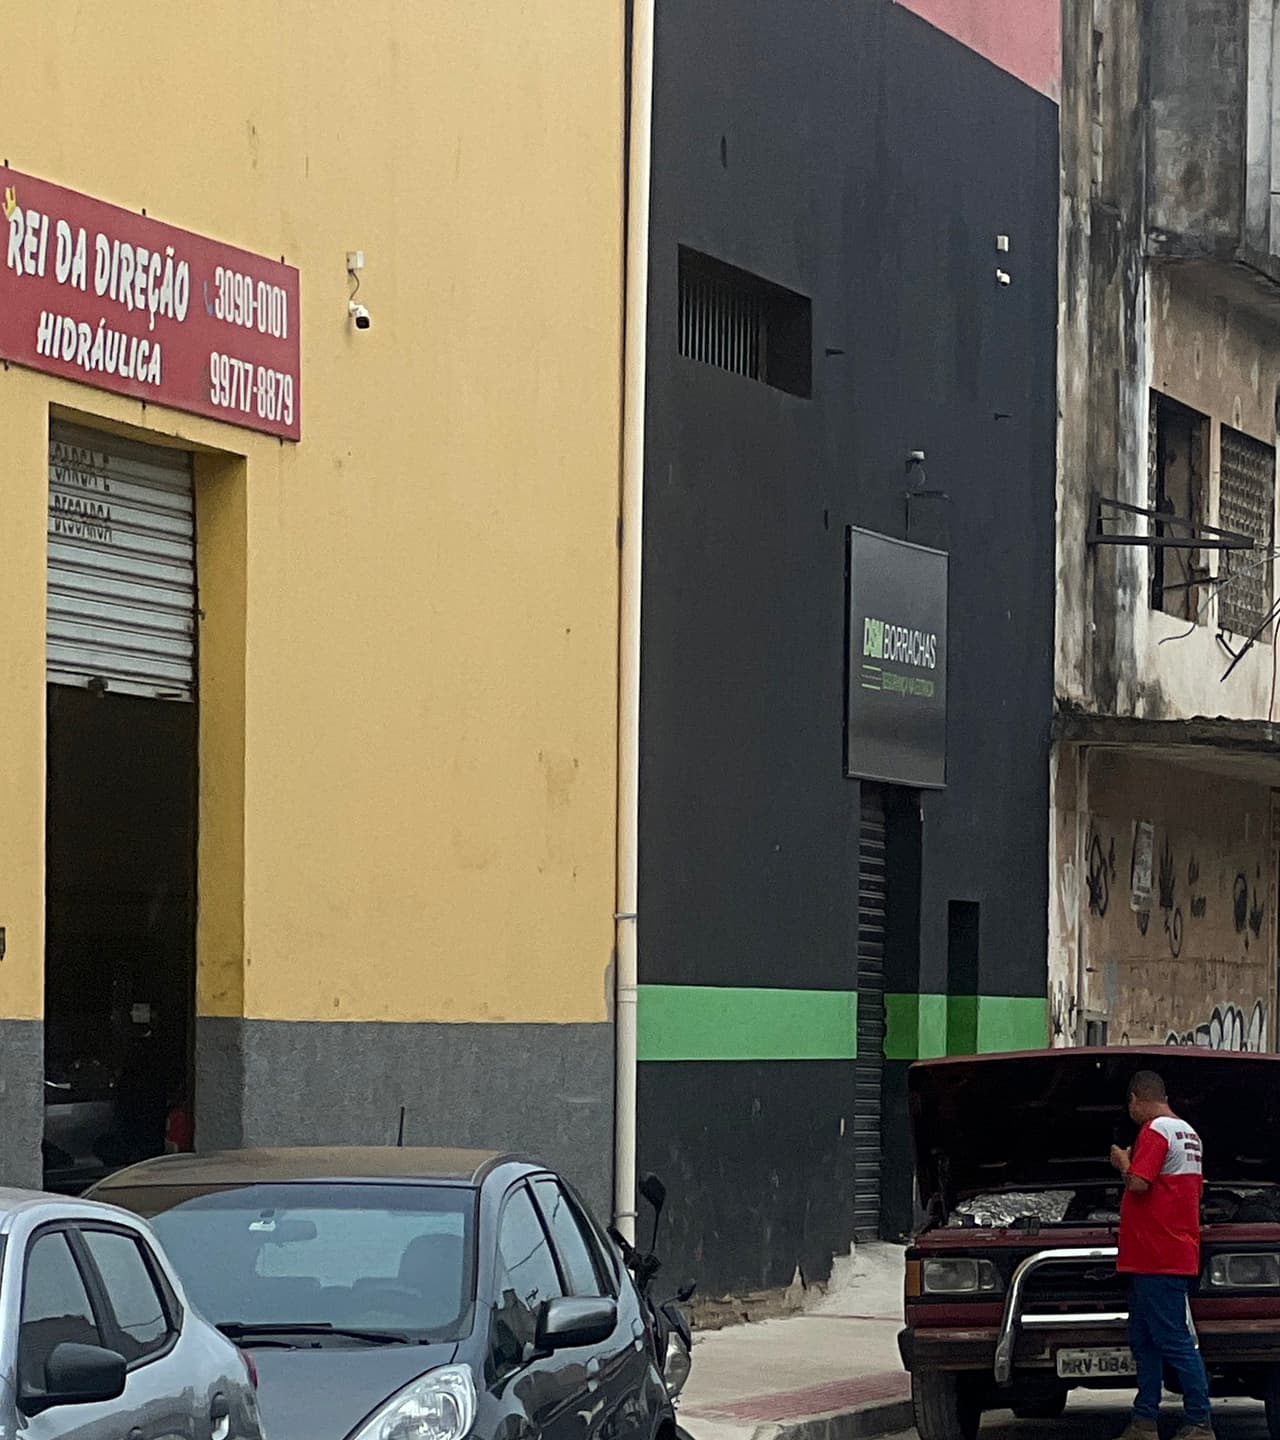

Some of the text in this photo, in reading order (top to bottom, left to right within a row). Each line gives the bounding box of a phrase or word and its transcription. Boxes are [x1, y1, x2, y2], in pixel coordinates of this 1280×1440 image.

[6, 205, 190, 331] REI DA DIREÇÃO
[214, 266, 288, 339] 3090-0101
[36, 311, 162, 385] HIDRÁULICA
[210, 352, 294, 426] 99717-8879
